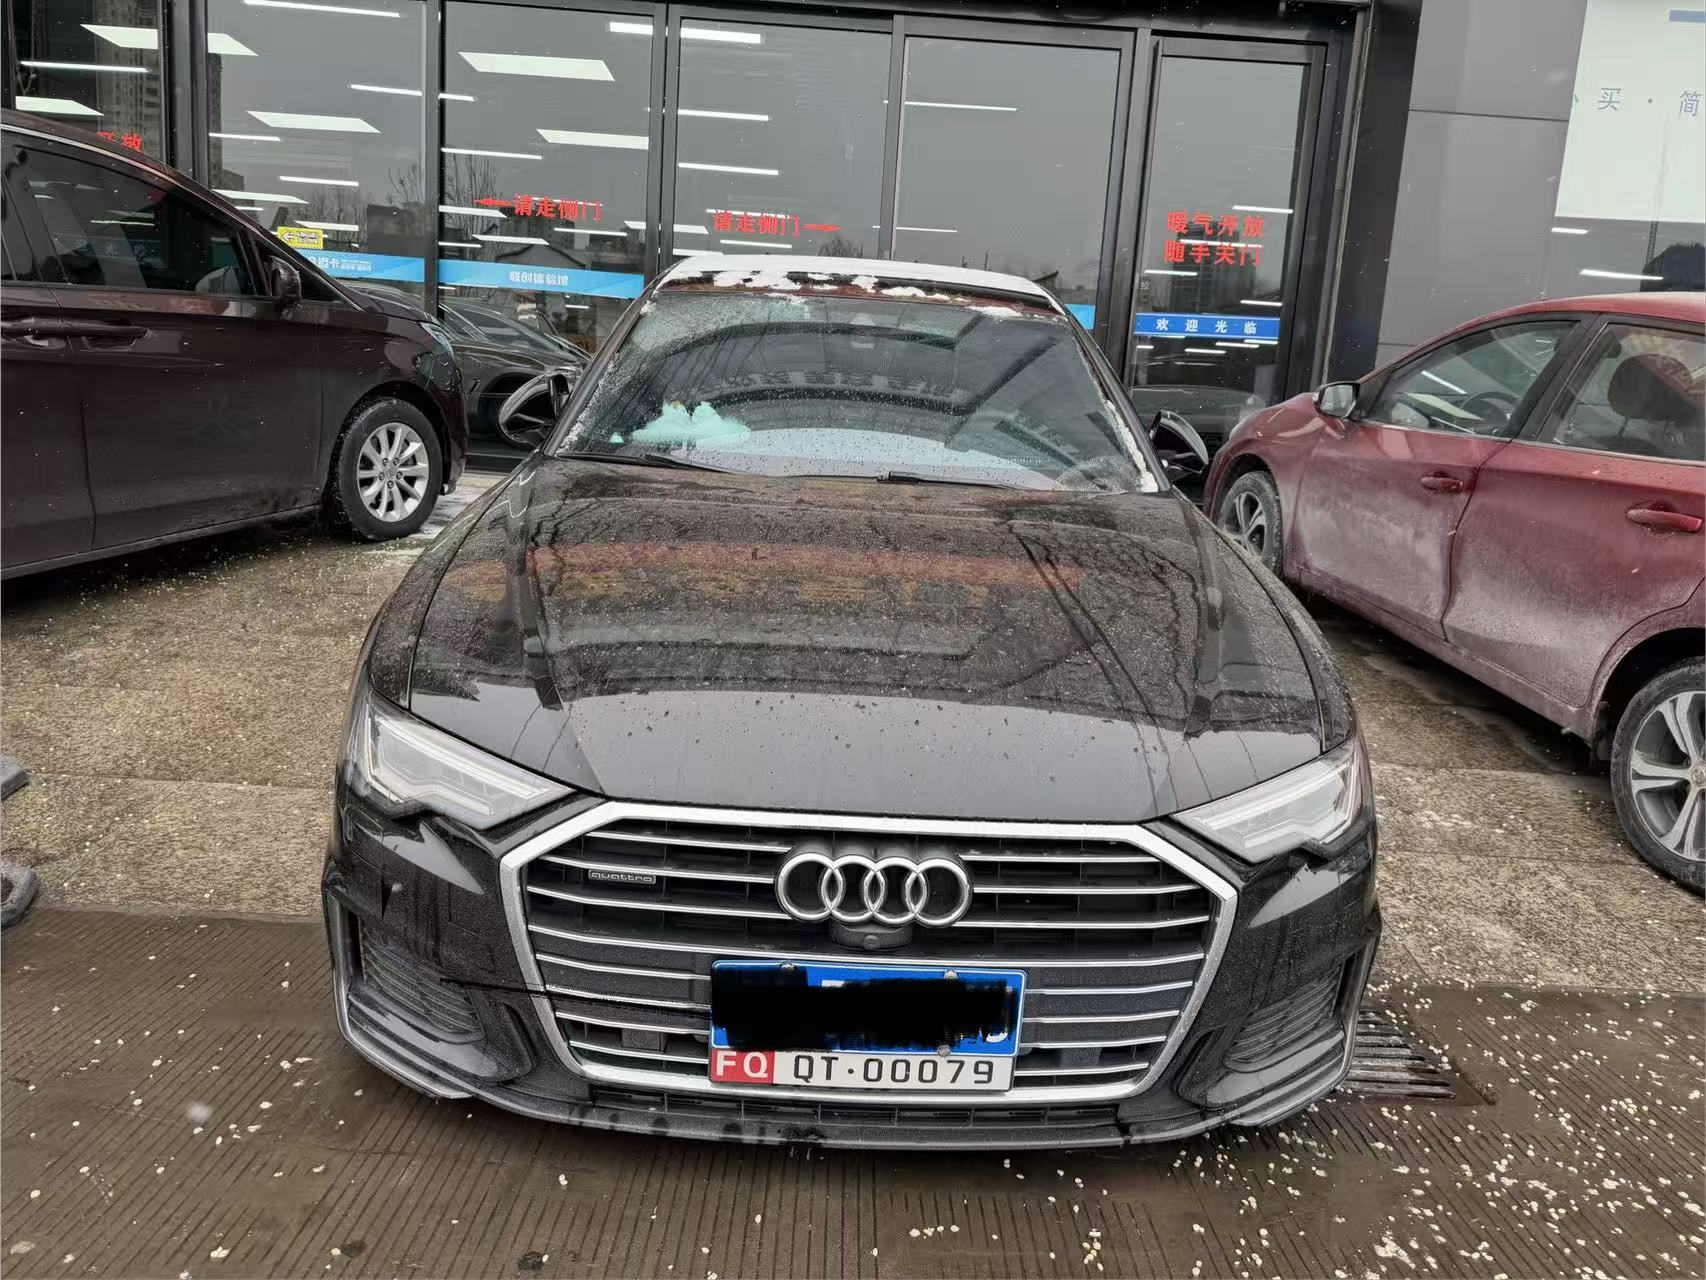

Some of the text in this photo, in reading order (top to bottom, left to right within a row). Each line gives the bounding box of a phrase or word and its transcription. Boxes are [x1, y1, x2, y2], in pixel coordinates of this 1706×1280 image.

[1573, 87, 1703, 117] 买·简
[514, 194, 603, 222] 请走侧门
[713, 209, 800, 239] 请走侧门
[1166, 210, 1265, 238] 暖气开放
[1164, 239, 1262, 267] 随手关门
[1155, 317, 1258, 335] 欢迎光临
[591, 871, 653, 883] quattro
[715, 1050, 769, 1080] FQ
